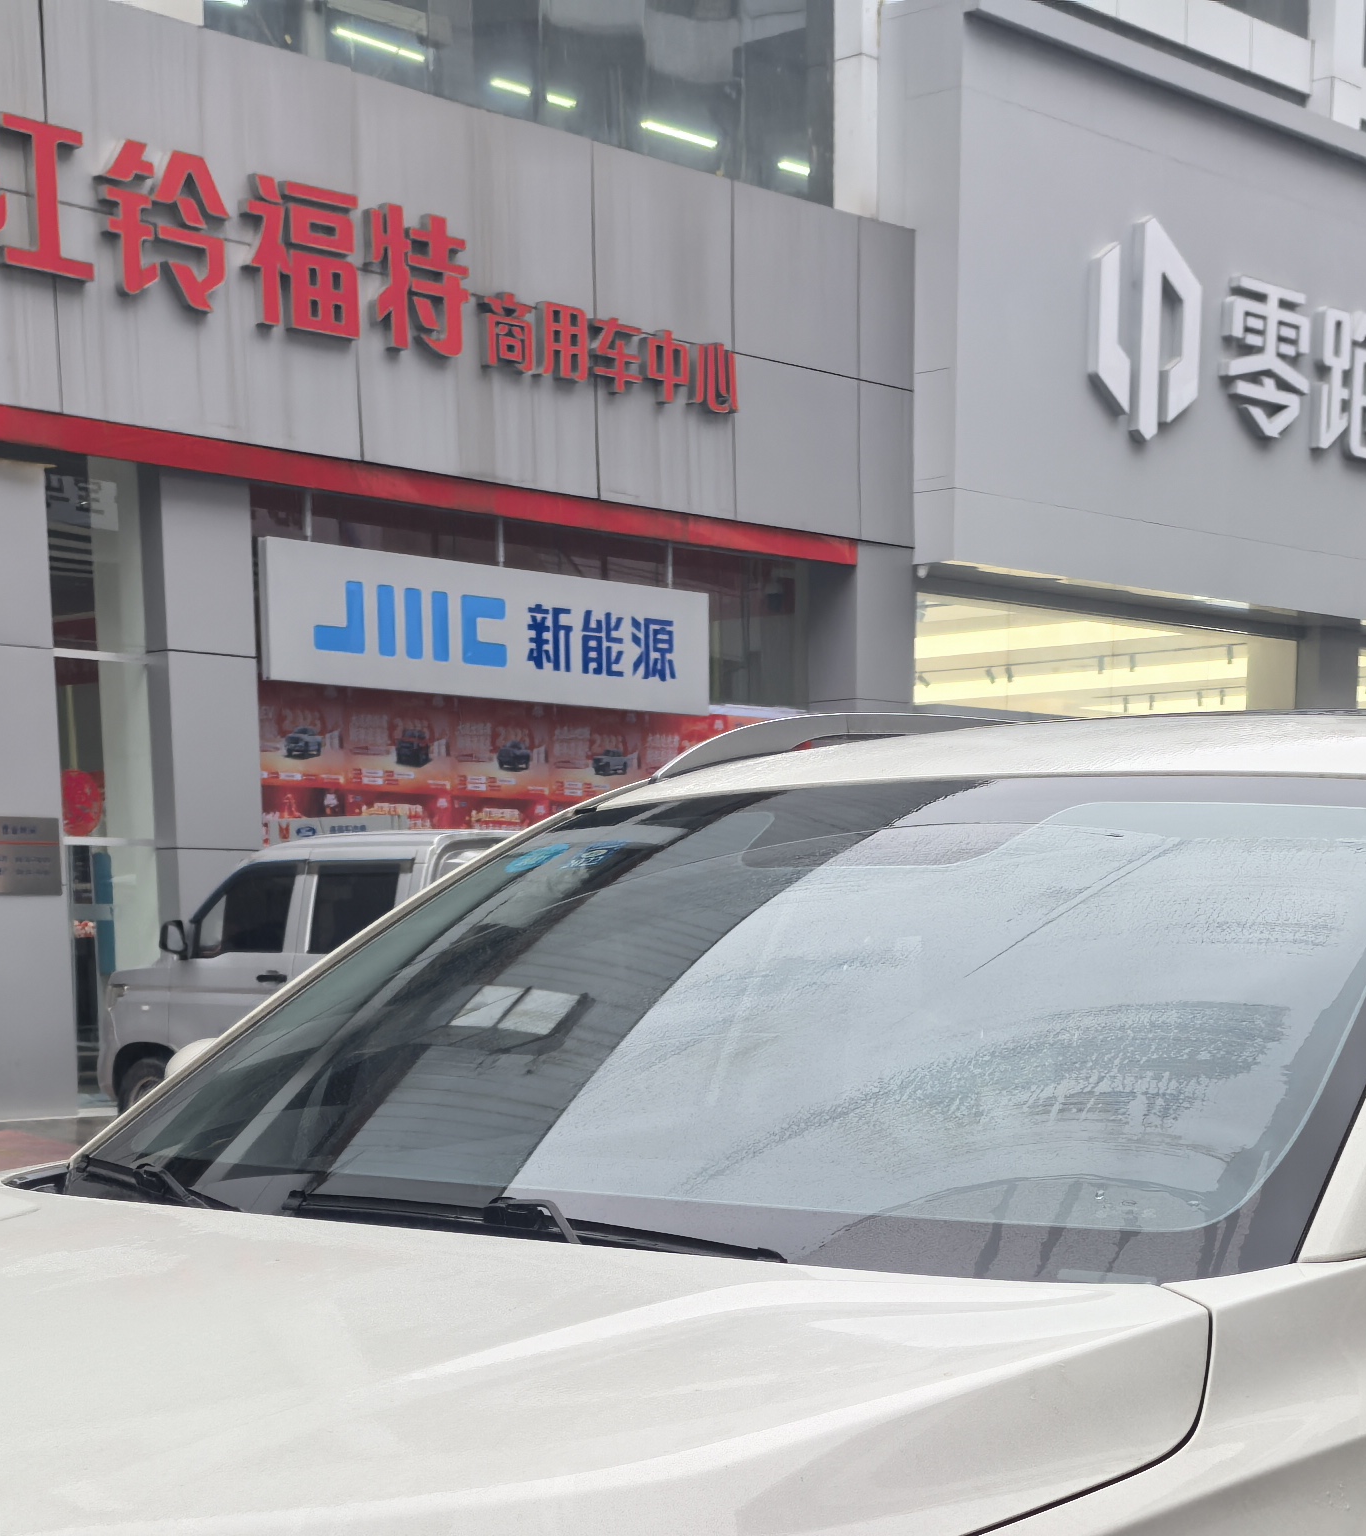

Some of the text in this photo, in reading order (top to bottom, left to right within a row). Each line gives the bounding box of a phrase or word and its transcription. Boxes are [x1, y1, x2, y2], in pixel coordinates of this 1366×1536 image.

[477, 292, 739, 413] 商用车中心
[527, 603, 677, 681] 新能源
